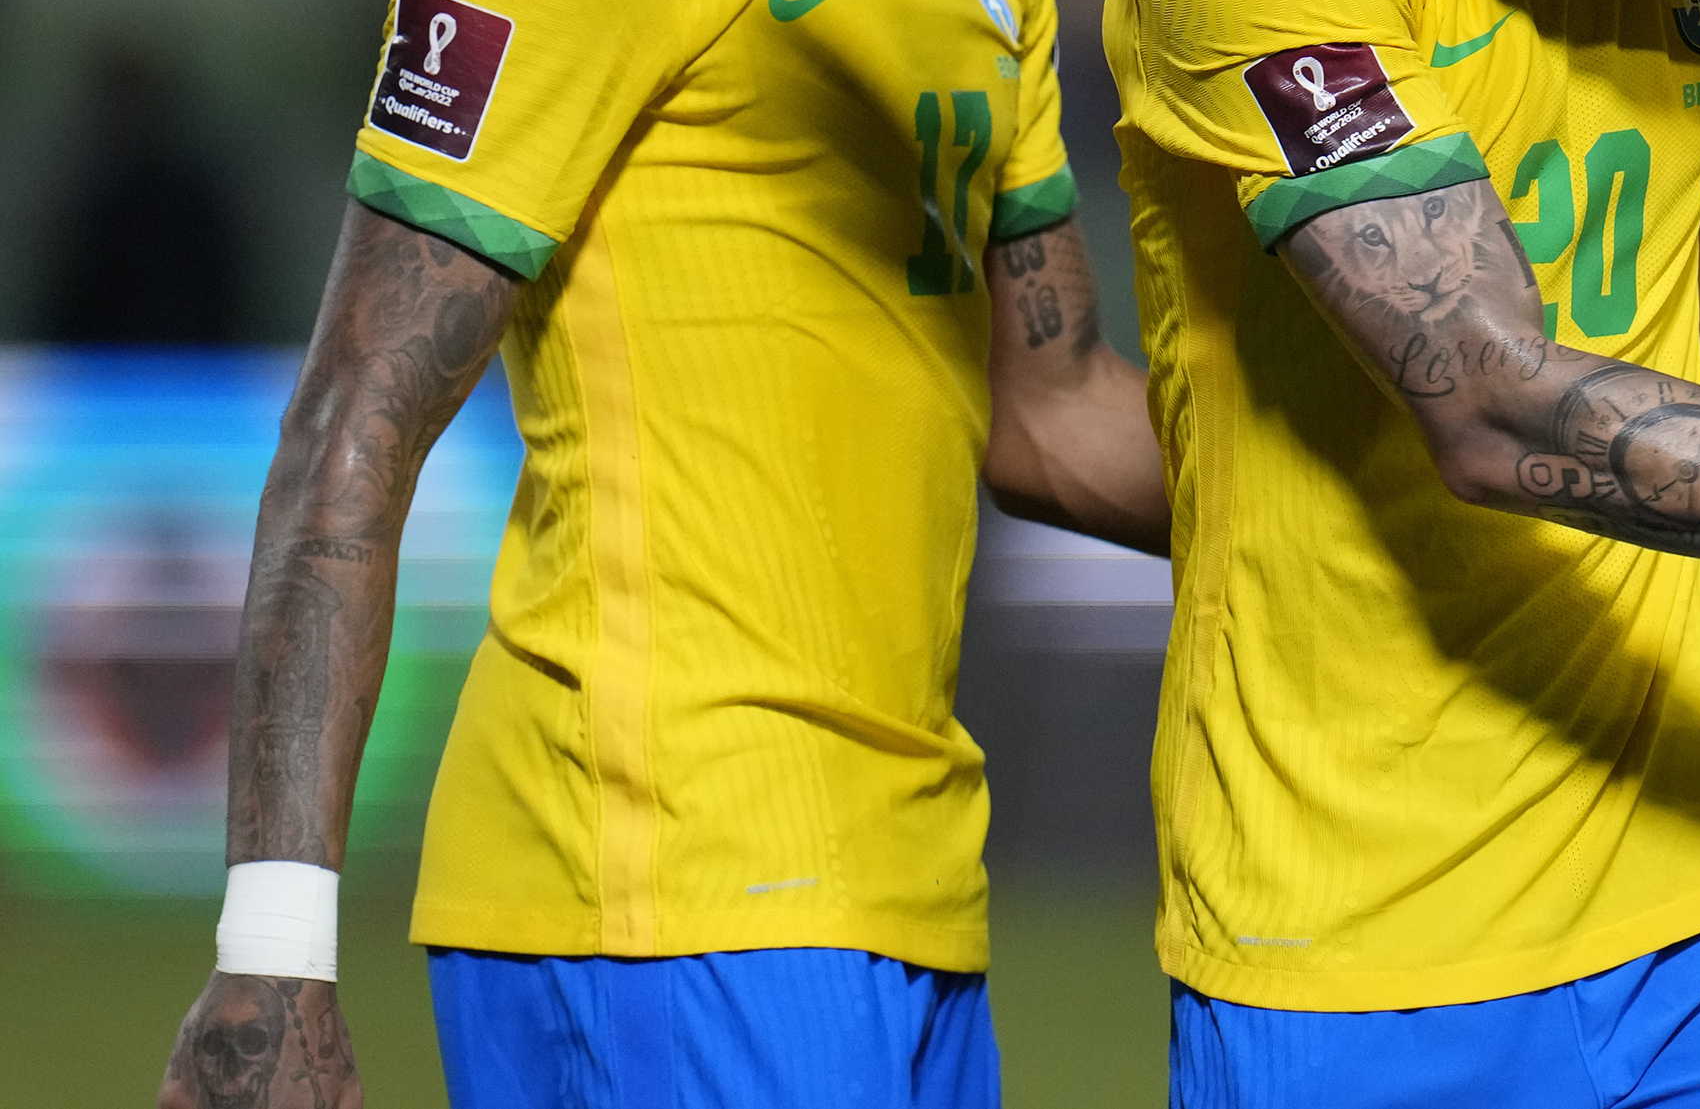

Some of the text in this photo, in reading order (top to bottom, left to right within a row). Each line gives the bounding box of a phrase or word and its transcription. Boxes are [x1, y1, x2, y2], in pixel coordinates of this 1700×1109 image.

[440, 85, 460, 98] CUP
[385, 95, 454, 134] Qualifiers
[1304, 124, 1322, 139] FIFA
[1316, 107, 1348, 129] WORLD
[1315, 120, 1387, 169] Qualifiers
[907, 90, 992, 296] 17
[1510, 128, 1651, 339] 20
[1237, 936, 1260, 947] NIKE
